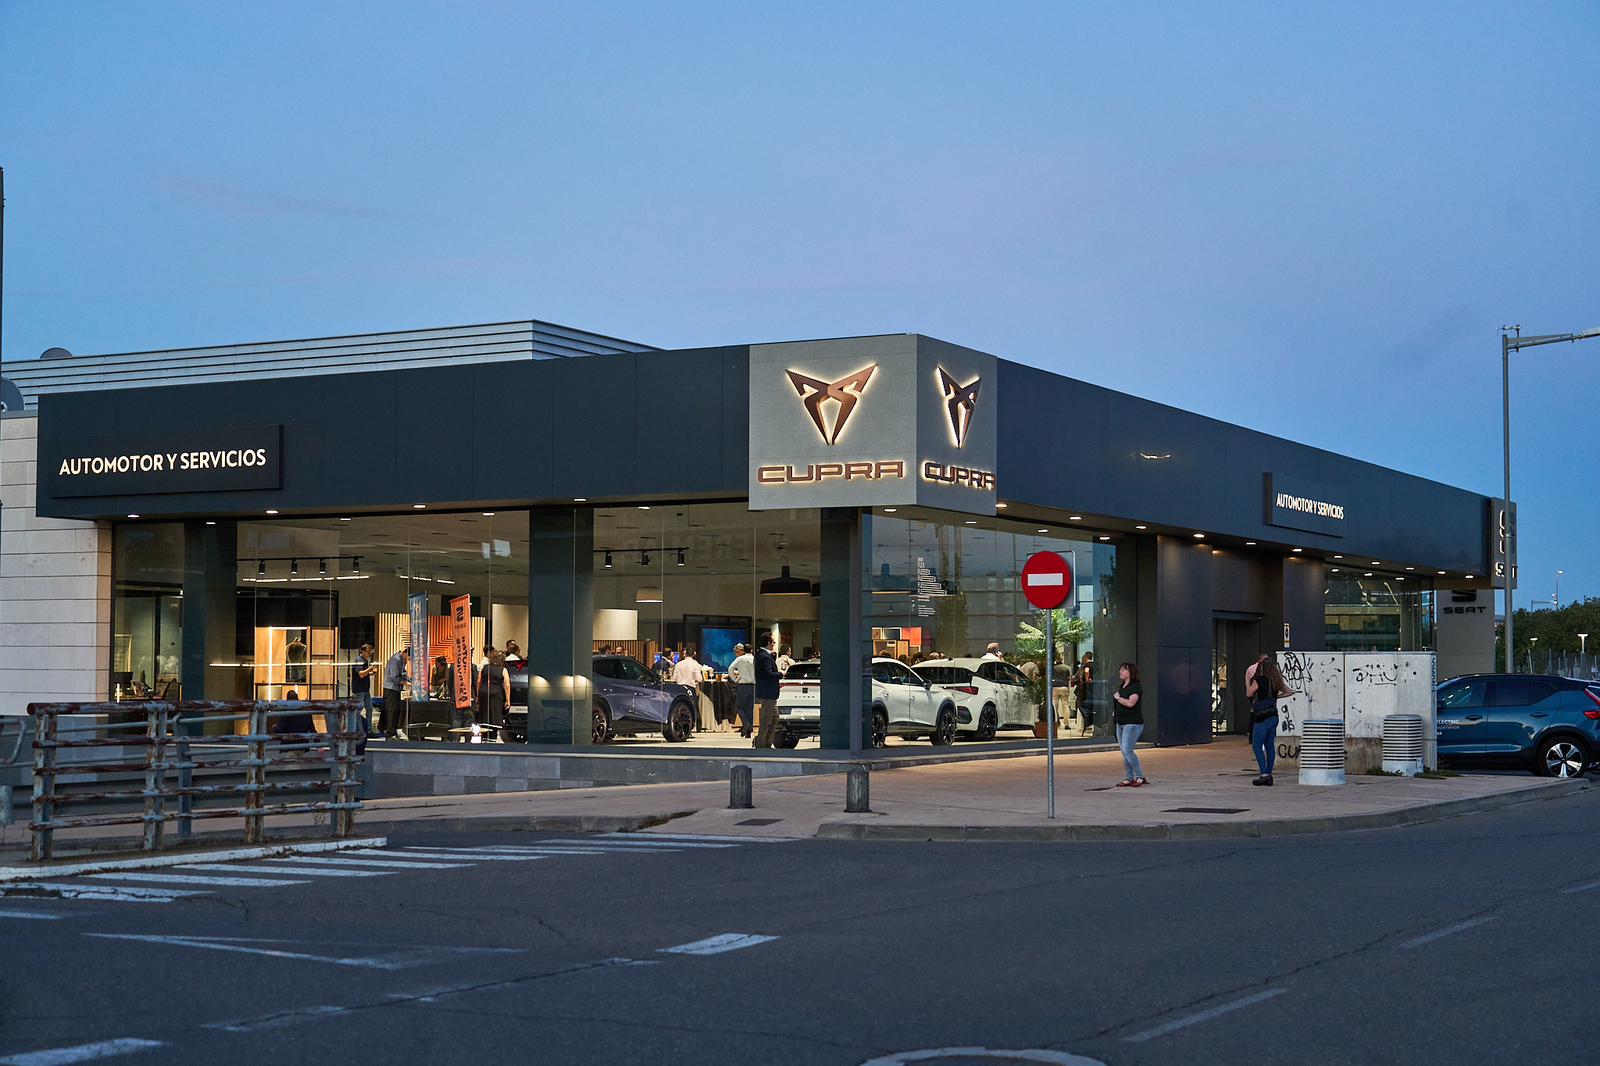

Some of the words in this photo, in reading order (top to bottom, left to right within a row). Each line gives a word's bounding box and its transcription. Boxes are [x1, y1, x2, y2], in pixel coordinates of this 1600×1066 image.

[59, 453, 164, 476] AUTOMOTOR
[166, 453, 178, 470] Y
[180, 448, 267, 470] SERVICIOS
[757, 461, 904, 483] CUPRA
[923, 462, 996, 491] CUPRA
[1276, 492, 1313, 514] AUTOMOTOR
[1313, 500, 1318, 514] Y
[1317, 501, 1344, 520] SERVICIOS
[1443, 606, 1487, 614] SEAT
